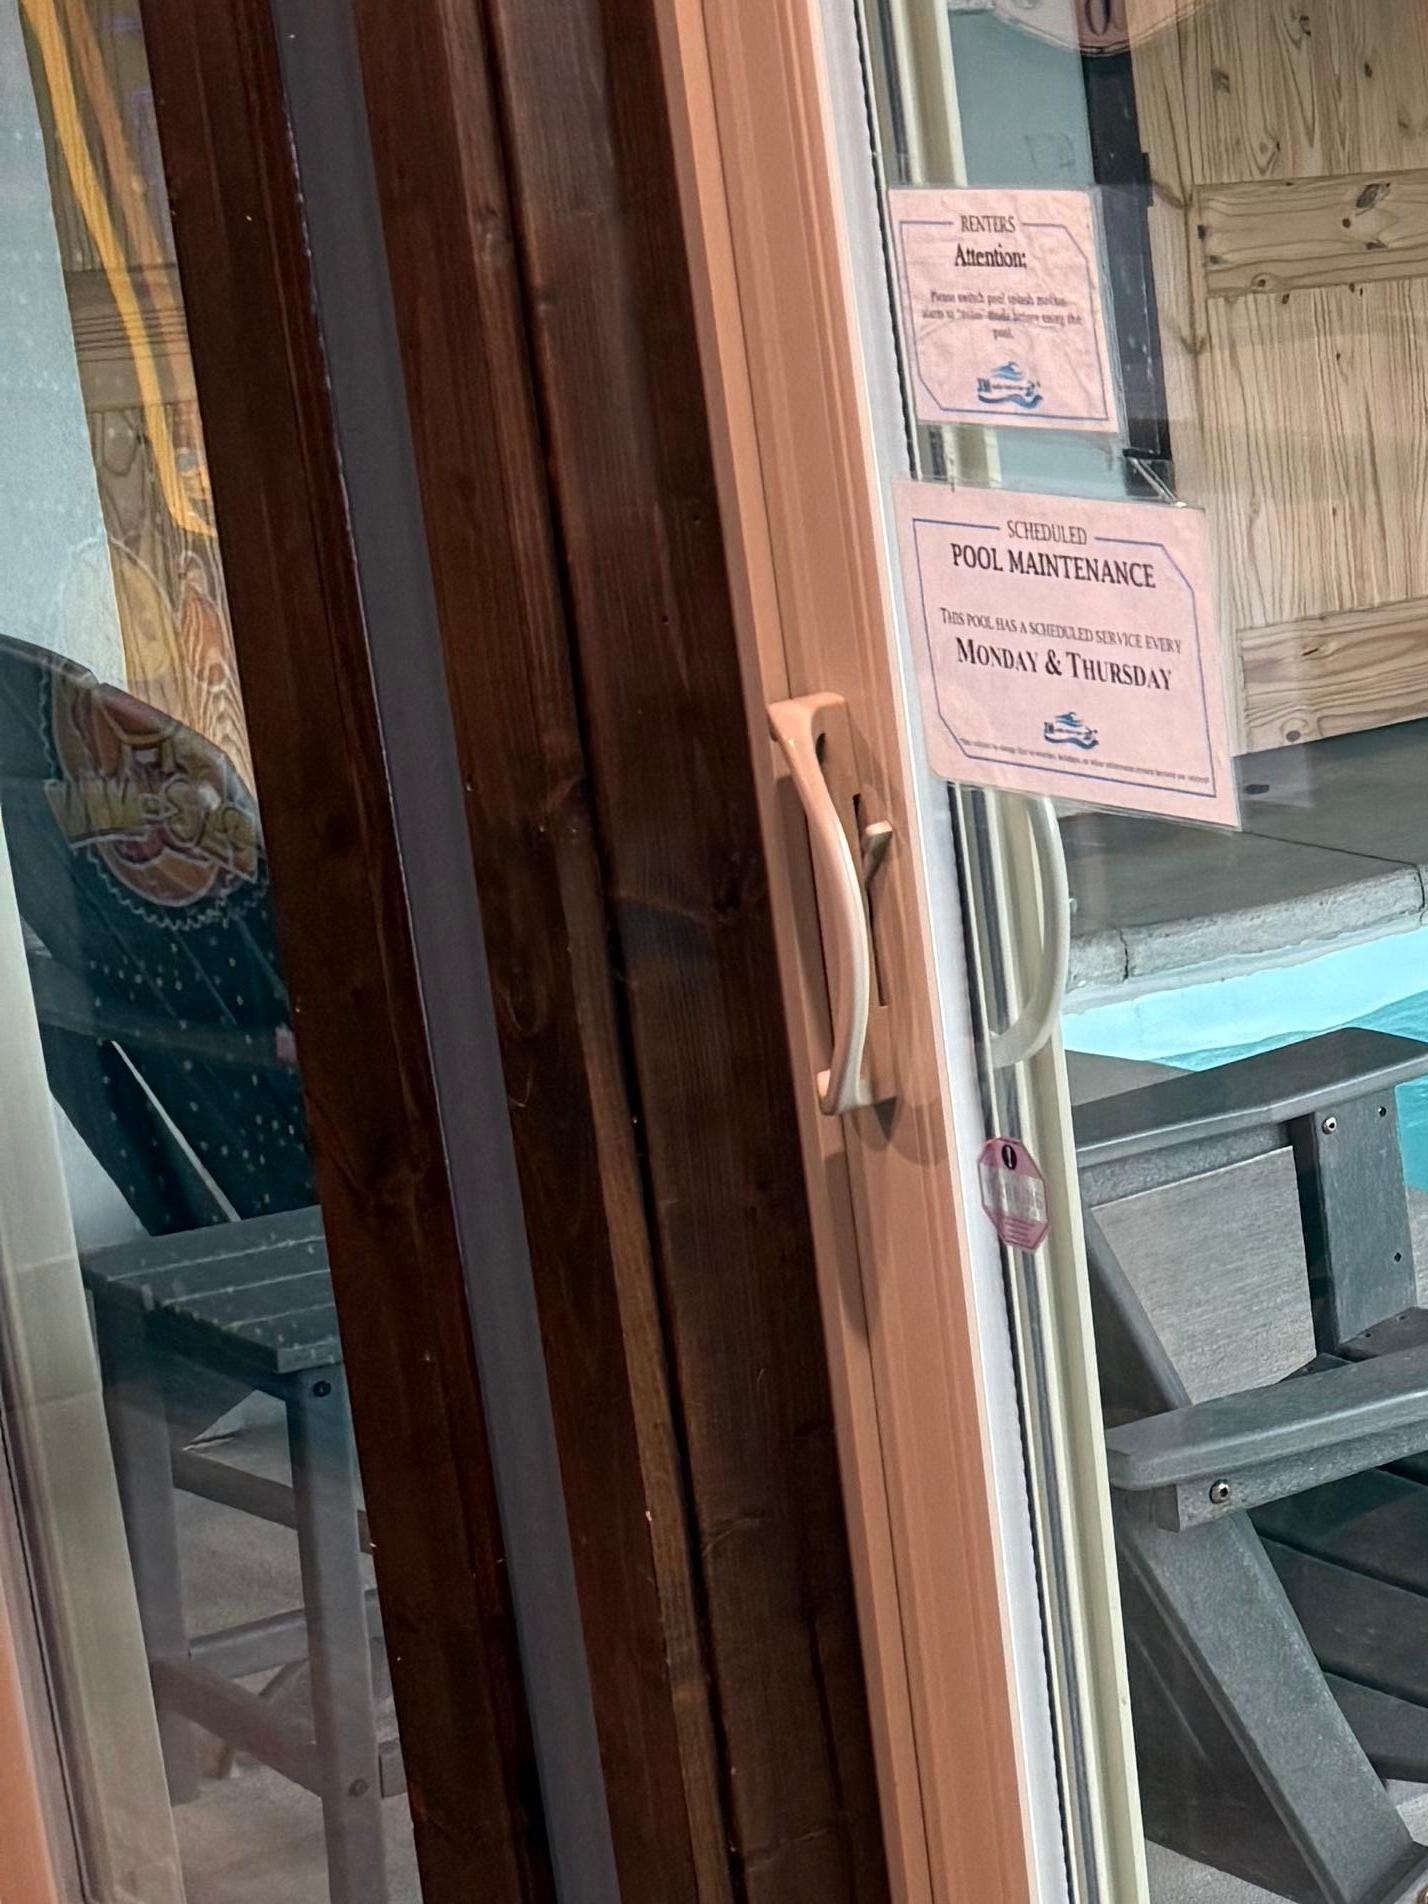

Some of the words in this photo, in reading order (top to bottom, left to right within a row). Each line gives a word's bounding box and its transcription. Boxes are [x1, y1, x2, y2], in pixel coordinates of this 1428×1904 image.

[960, 214, 1016, 234] RENTERS
[954, 242, 1027, 269] Attention:
[1007, 519, 1088, 545] SCHEDULED
[951, 543, 1003, 572] POOL
[1009, 548, 1156, 589] MAINTENANCE
[1029, 621, 1094, 643] SCHEDULED
[1096, 629, 1142, 651] SERVICE
[1145, 634, 1182, 655] EVERY
[1045, 649, 1063, 677] &
